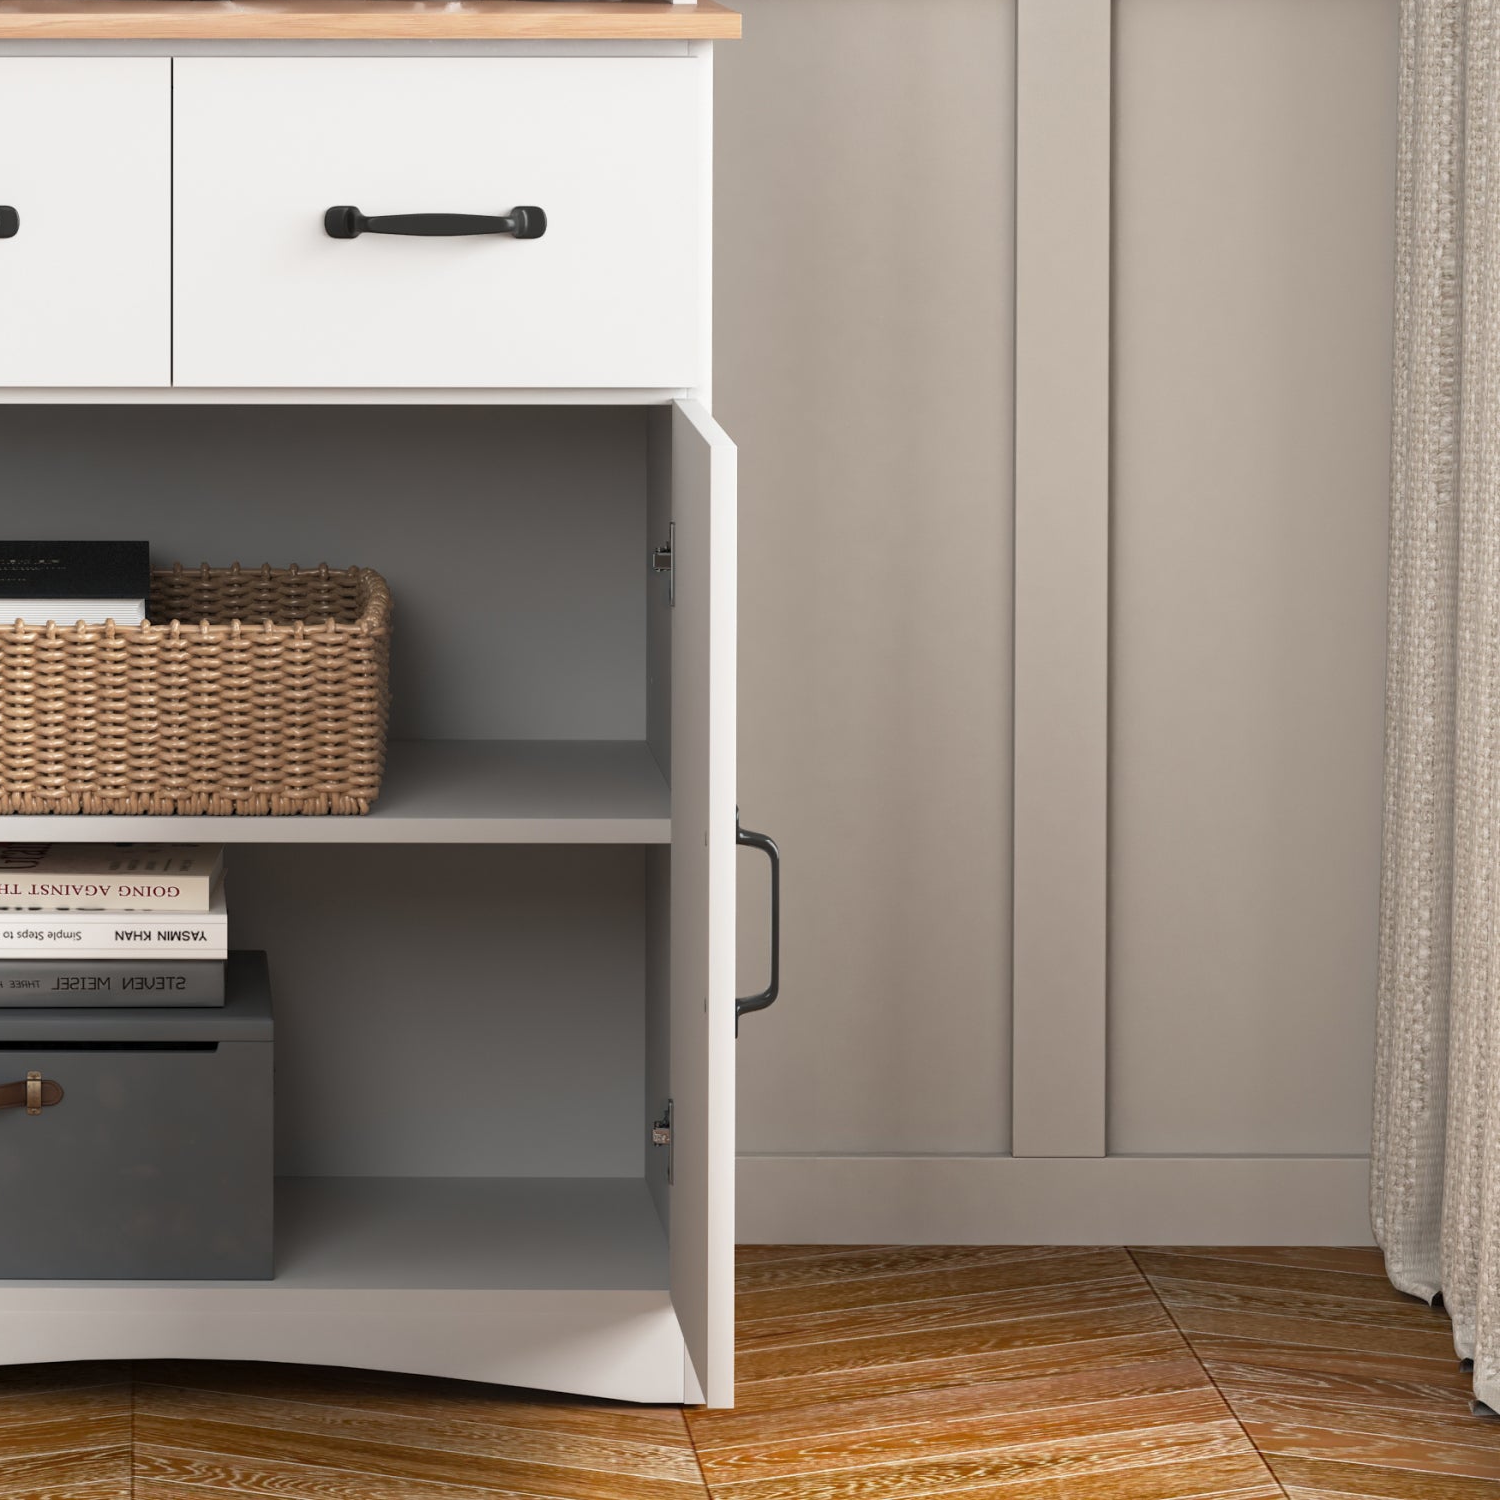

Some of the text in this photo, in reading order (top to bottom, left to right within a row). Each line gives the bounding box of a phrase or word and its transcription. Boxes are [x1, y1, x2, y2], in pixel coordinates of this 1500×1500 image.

[29, 885, 111, 896] AGAINST
[119, 886, 179, 897] GOING
[3, 931, 13, 939] to
[17, 930, 44, 940] Steps
[47, 930, 82, 941] Simple
[115, 931, 151, 941] KHAN
[158, 931, 207, 941] YASMIN
